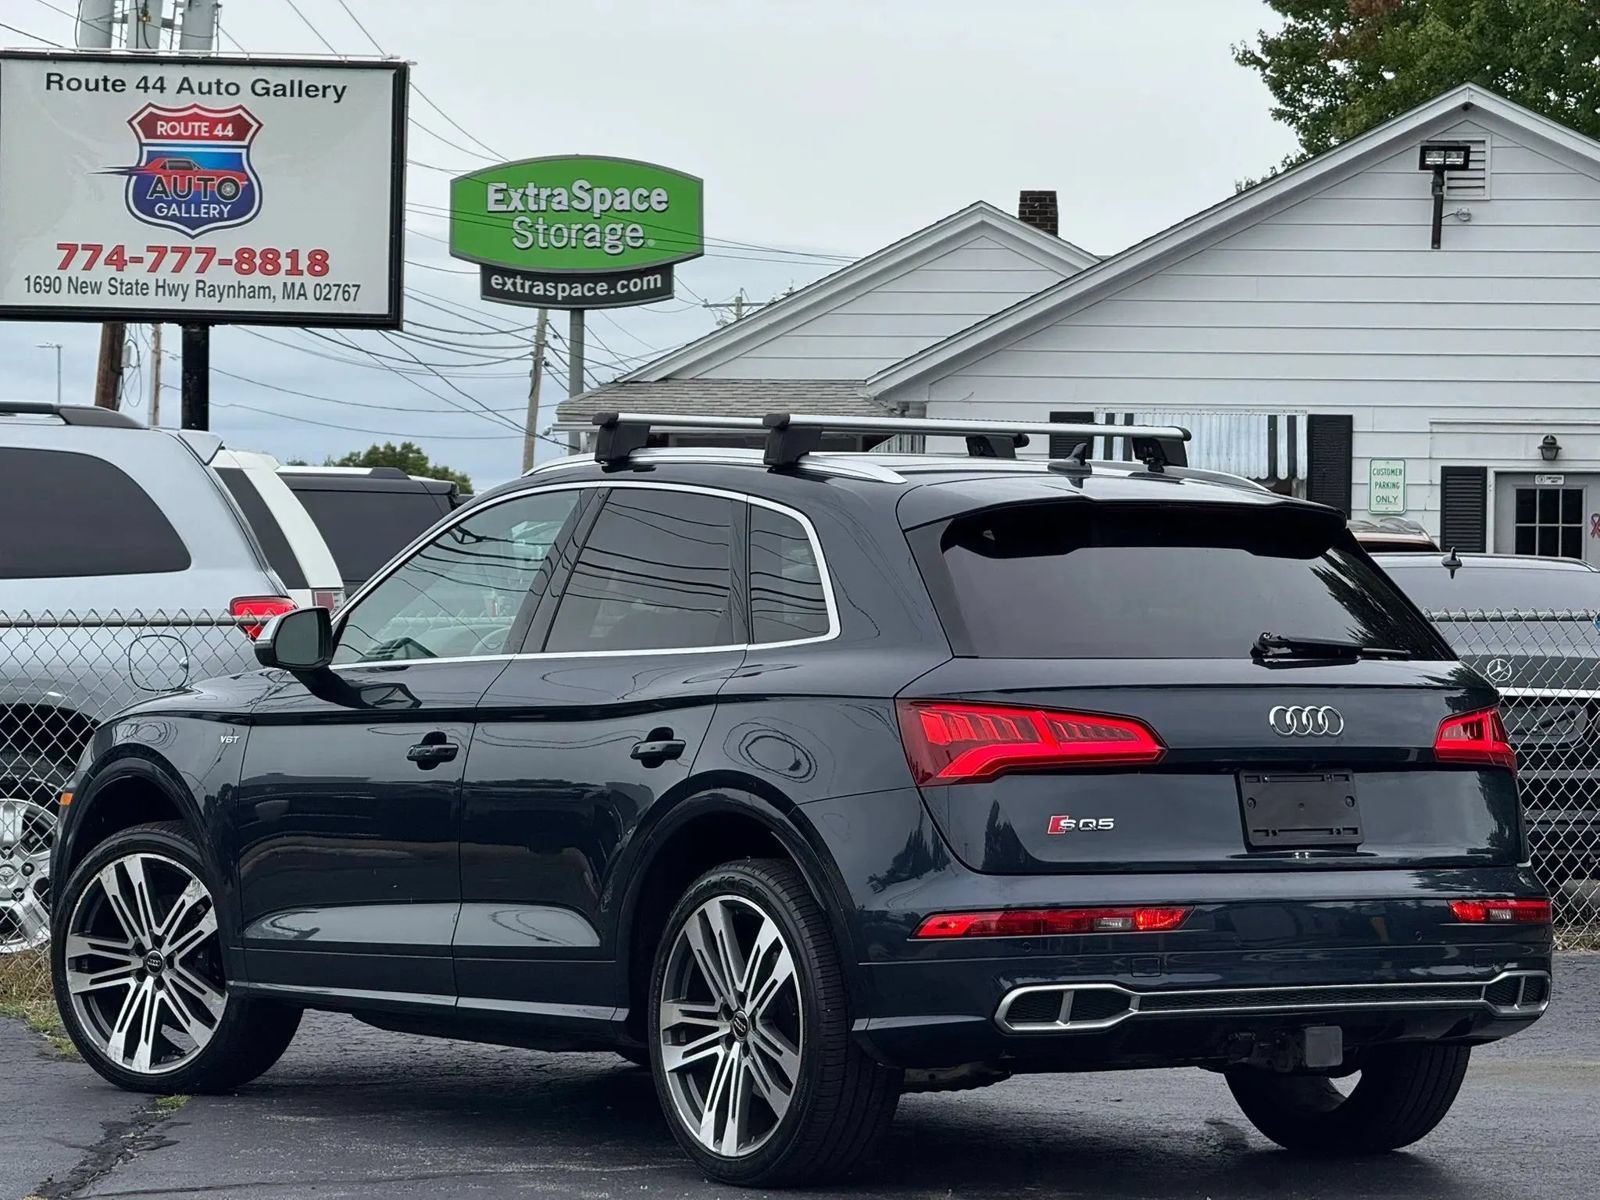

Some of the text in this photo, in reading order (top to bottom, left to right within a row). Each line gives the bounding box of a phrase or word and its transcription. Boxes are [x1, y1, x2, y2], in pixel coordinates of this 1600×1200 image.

[45, 72, 347, 103] Route 44 Auto Gallery
[156, 121, 234, 137] ROUTE 44
[146, 175, 242, 203] AUTO
[154, 202, 232, 218] GALLERY
[512, 216, 645, 254] Storage
[56, 243, 330, 277] 774-777-8818
[24, 274, 361, 303] 1690 New State Hwy Raynham, MA 02767
[490, 273, 662, 301] extraspace.com
[1372, 468, 1403, 476] CUSTOMER
[1374, 481, 1400, 490] PARKING
[1375, 495, 1398, 503] ONLY
[220, 735, 240, 744] V6T
